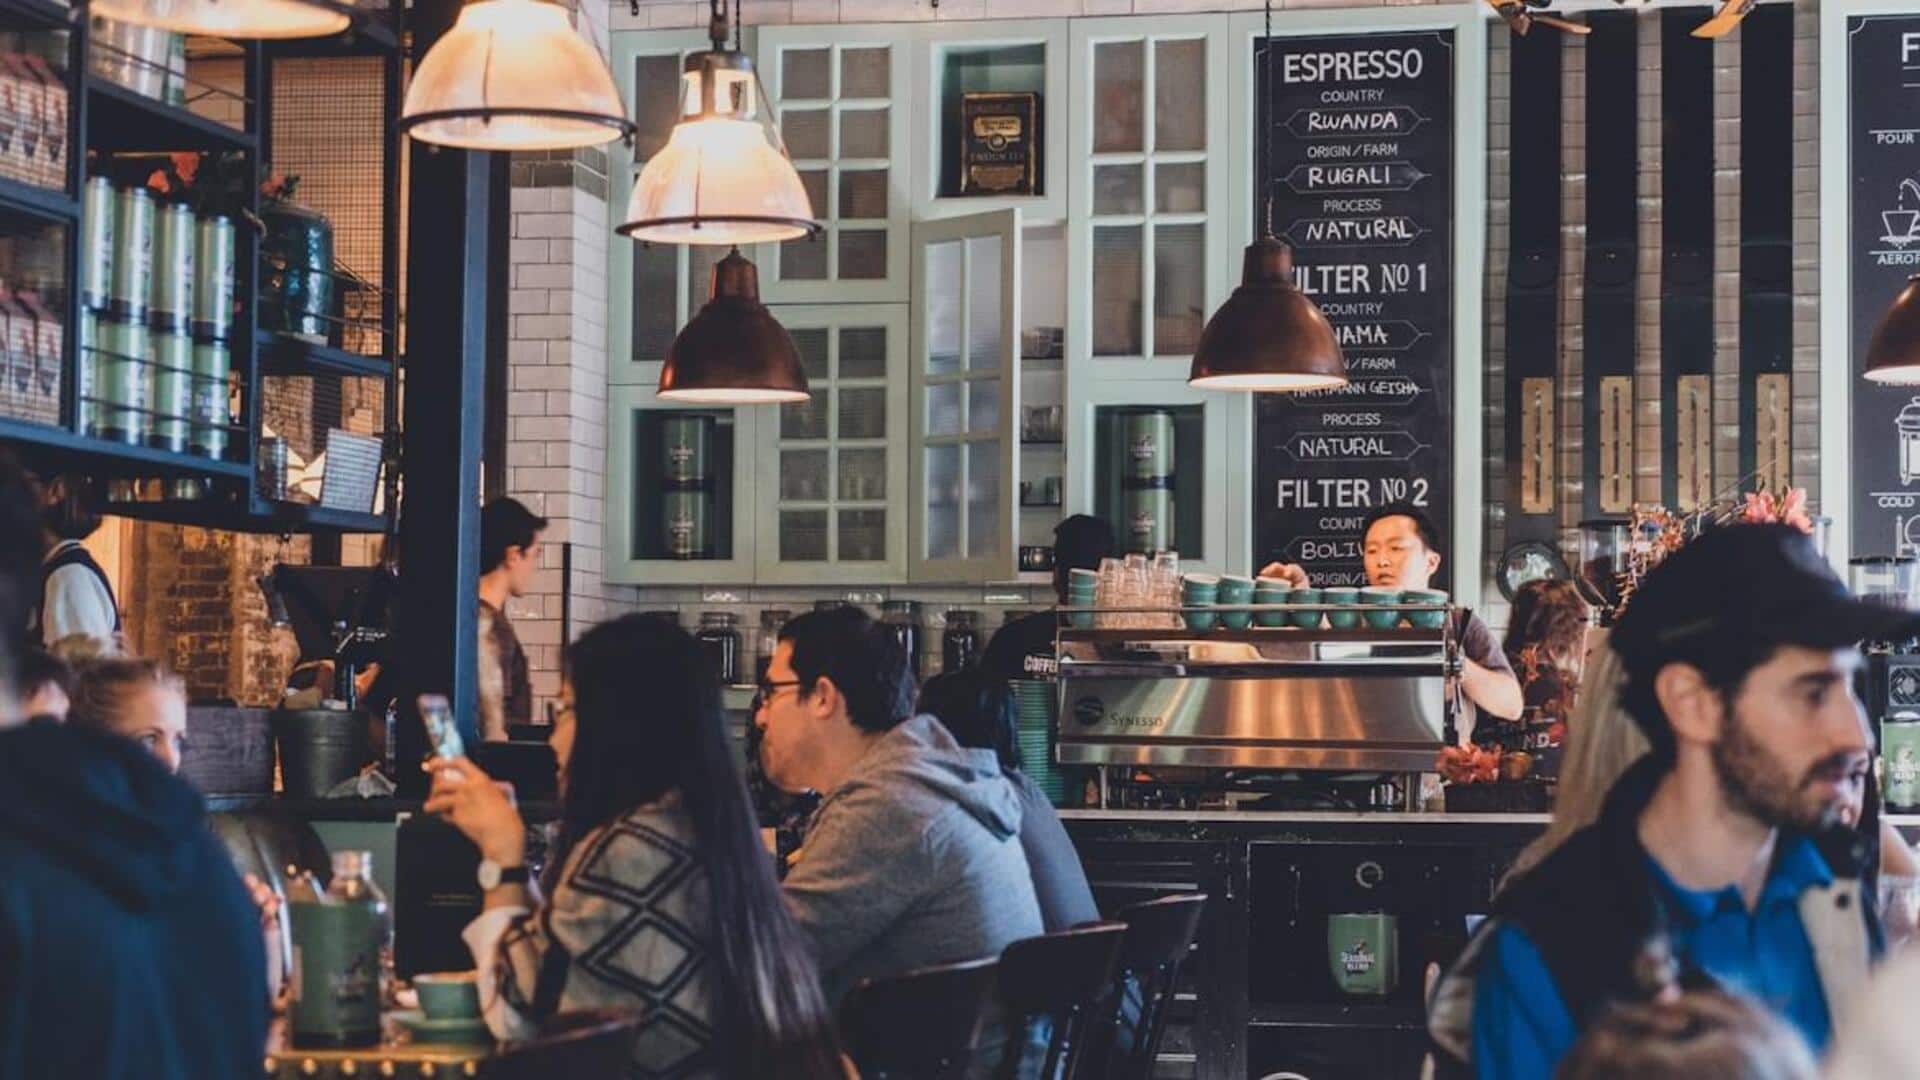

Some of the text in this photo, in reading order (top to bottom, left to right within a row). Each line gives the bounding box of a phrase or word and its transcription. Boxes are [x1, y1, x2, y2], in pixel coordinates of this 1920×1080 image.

[1284, 48, 1423, 84] ESPRESSO
[1321, 89, 1384, 104] COUNTRY
[1308, 111, 1398, 132] RWANDA
[1877, 133, 1914, 145] POUR
[1307, 143, 1398, 159] ORIGIN/FARM
[1308, 165, 1390, 188] RUGALI
[1324, 199, 1382, 213] PROCESS
[1306, 218, 1413, 241] NATURAL
[1291, 264, 1371, 295] ILTER
[1417, 263, 1428, 292] 1
[1321, 302, 1384, 316] COUNTRY
[1322, 413, 1382, 427] PROCESS
[1299, 438, 1392, 457] NATURAL
[1276, 479, 1371, 510] FILTER
[1413, 478, 1430, 507] 2
[1878, 496, 1914, 507] COLD
